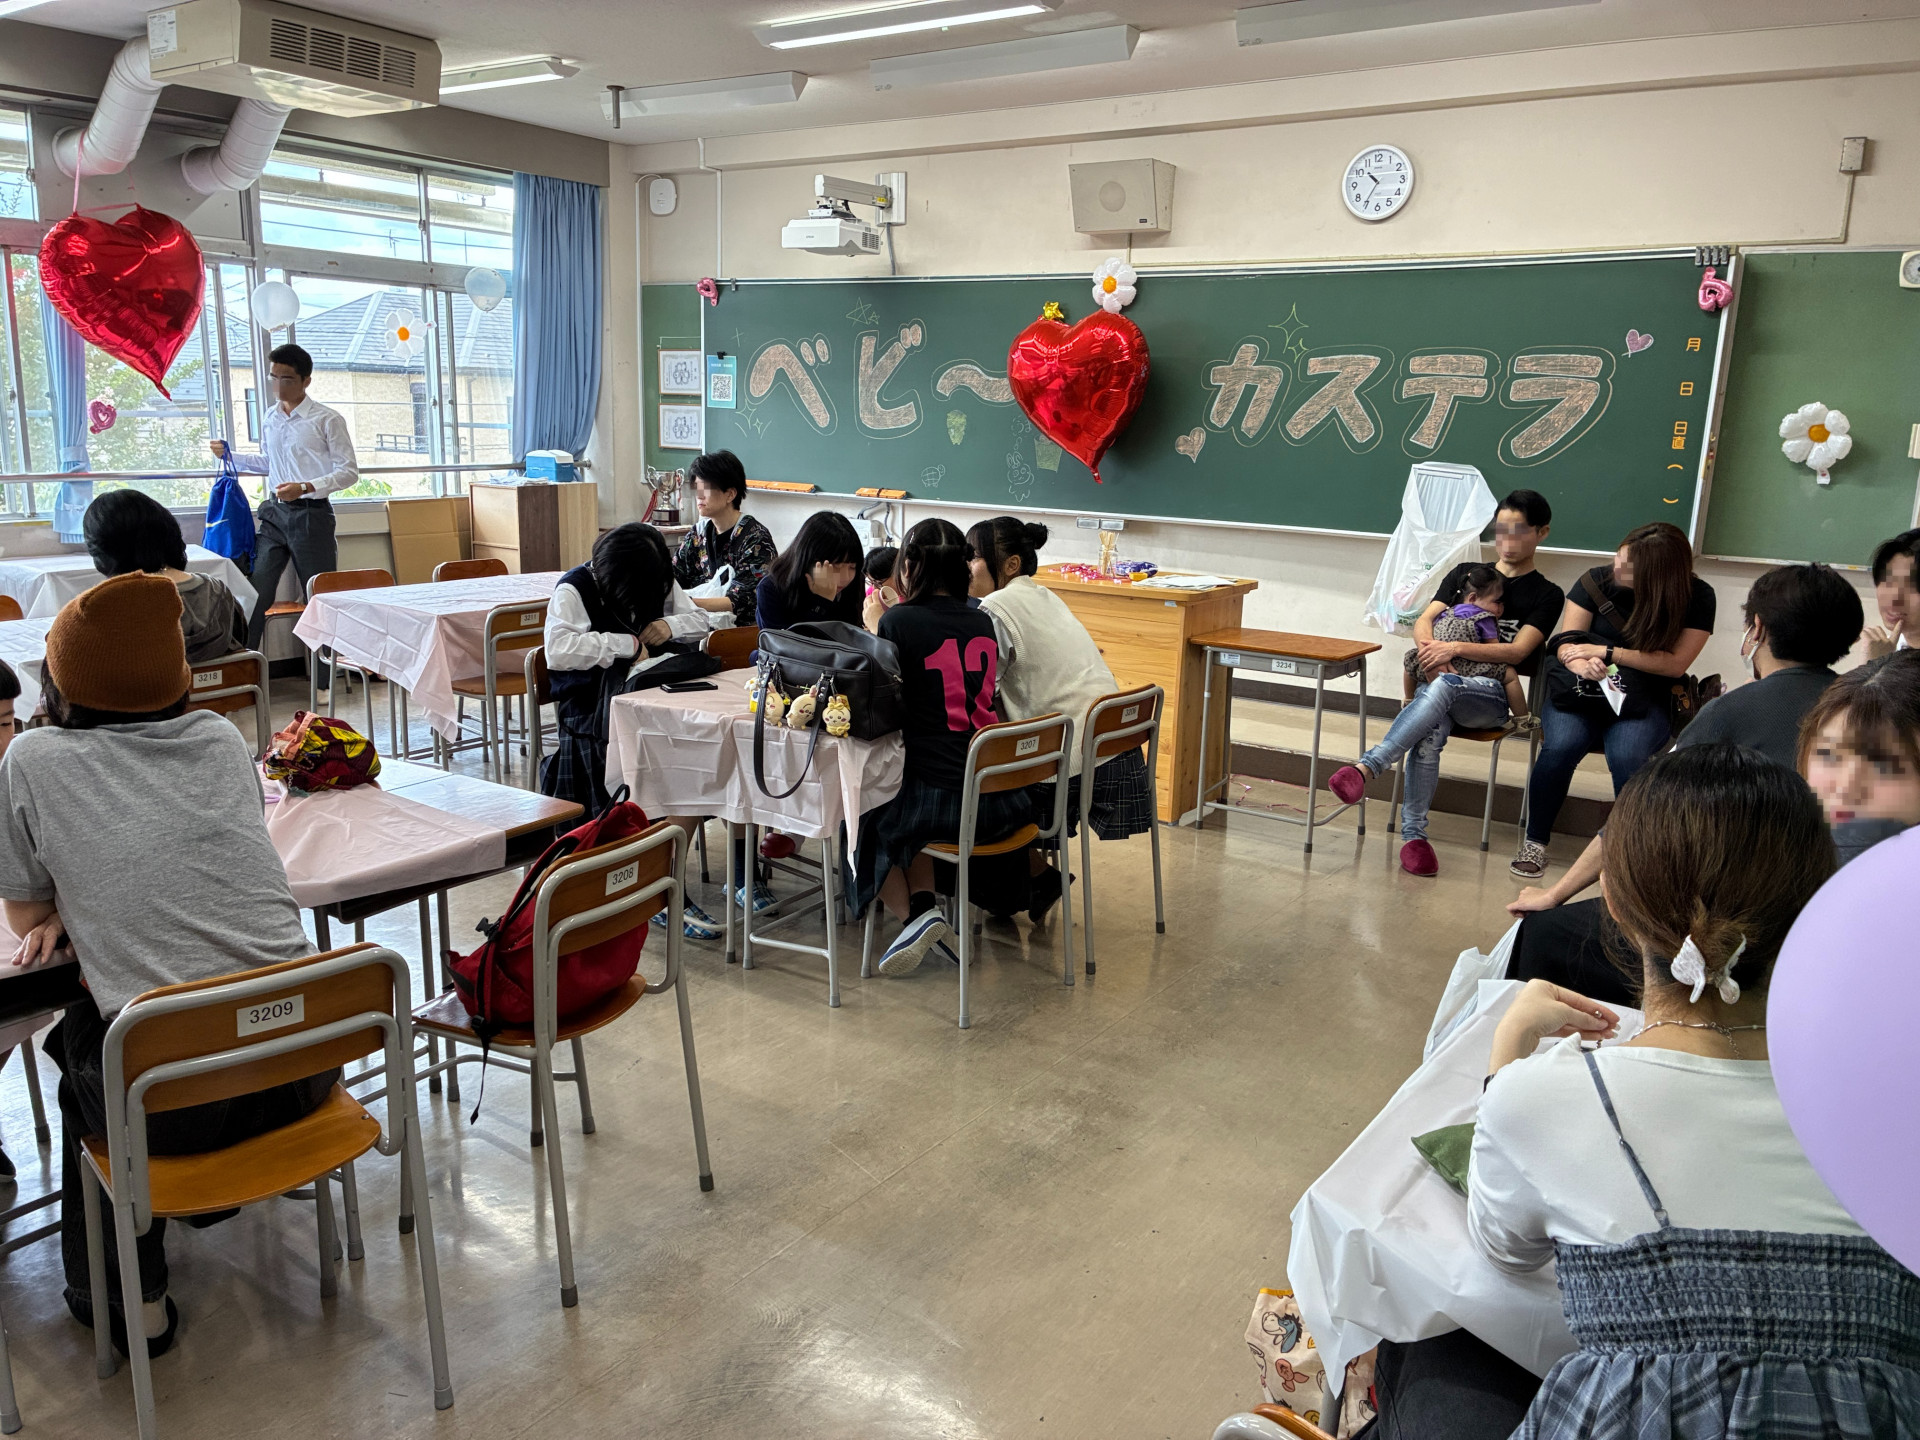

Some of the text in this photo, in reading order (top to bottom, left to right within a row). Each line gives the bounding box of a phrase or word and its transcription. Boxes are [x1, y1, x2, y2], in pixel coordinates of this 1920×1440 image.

[1374, 153, 1384, 163] 12
[1365, 159, 1371, 168] 11
[1396, 162, 1402, 171] 2
[1355, 168, 1364, 177] 10
[1399, 174, 1406, 184] 3
[1351, 181, 1358, 190] 9
[1394, 188, 1401, 196] 4
[1355, 193, 1361, 202] 8
[1386, 197, 1392, 206] 5
[1364, 200, 1369, 210] 7
[1374, 202, 1381, 211] 6
[1686, 337, 1701, 351] 月
[1680, 382, 1694, 396] 日
[1209, 343, 1603, 459] カステラ
[1671, 421, 1688, 449] 日直
[1275, 661, 1292, 669] 3234
[198, 672, 218, 682] 3218
[924, 636, 999, 731] 12
[1020, 739, 1036, 750] 3207
[612, 867, 634, 885] 3208
[249, 1001, 293, 1024] 3209
